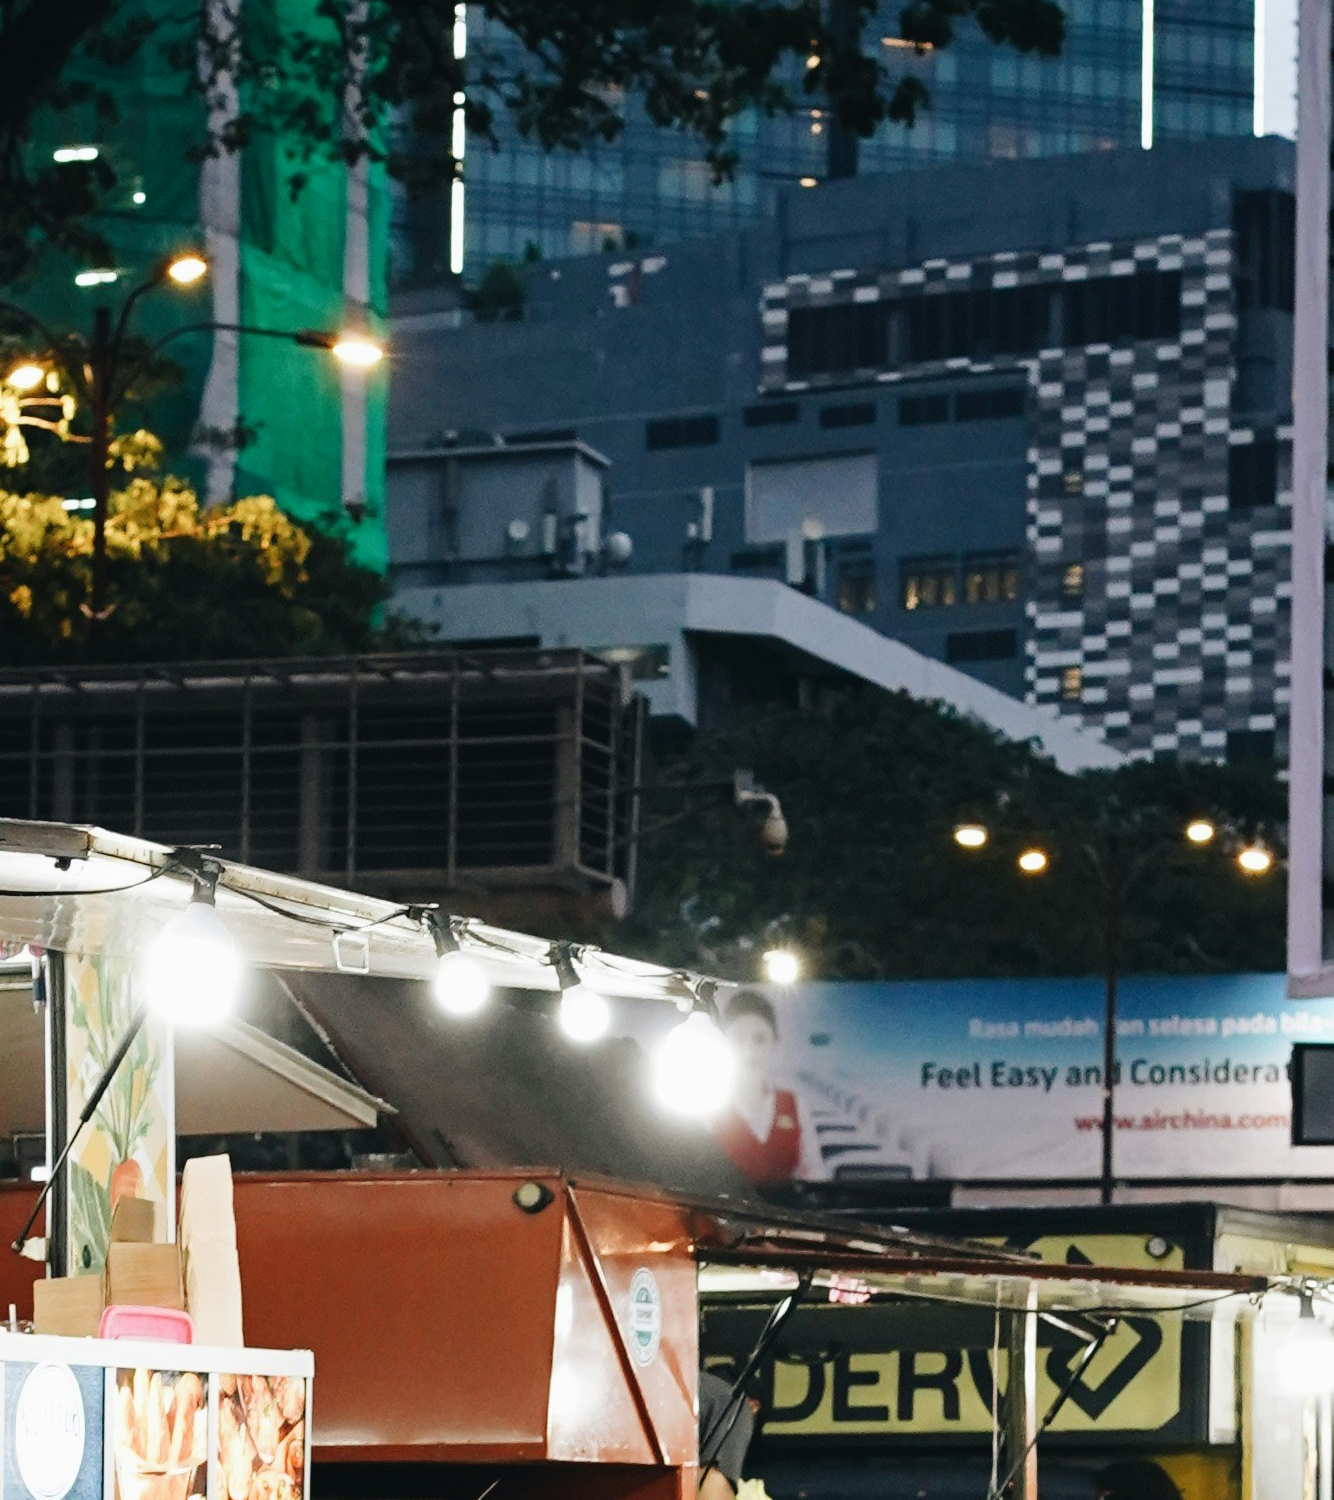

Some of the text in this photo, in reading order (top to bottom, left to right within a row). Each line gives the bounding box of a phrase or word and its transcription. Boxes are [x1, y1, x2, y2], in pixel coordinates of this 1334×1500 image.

[921, 1060, 981, 1089] Feel
[990, 1059, 1059, 1093] Easy
[1130, 1057, 1292, 1086] Considera
